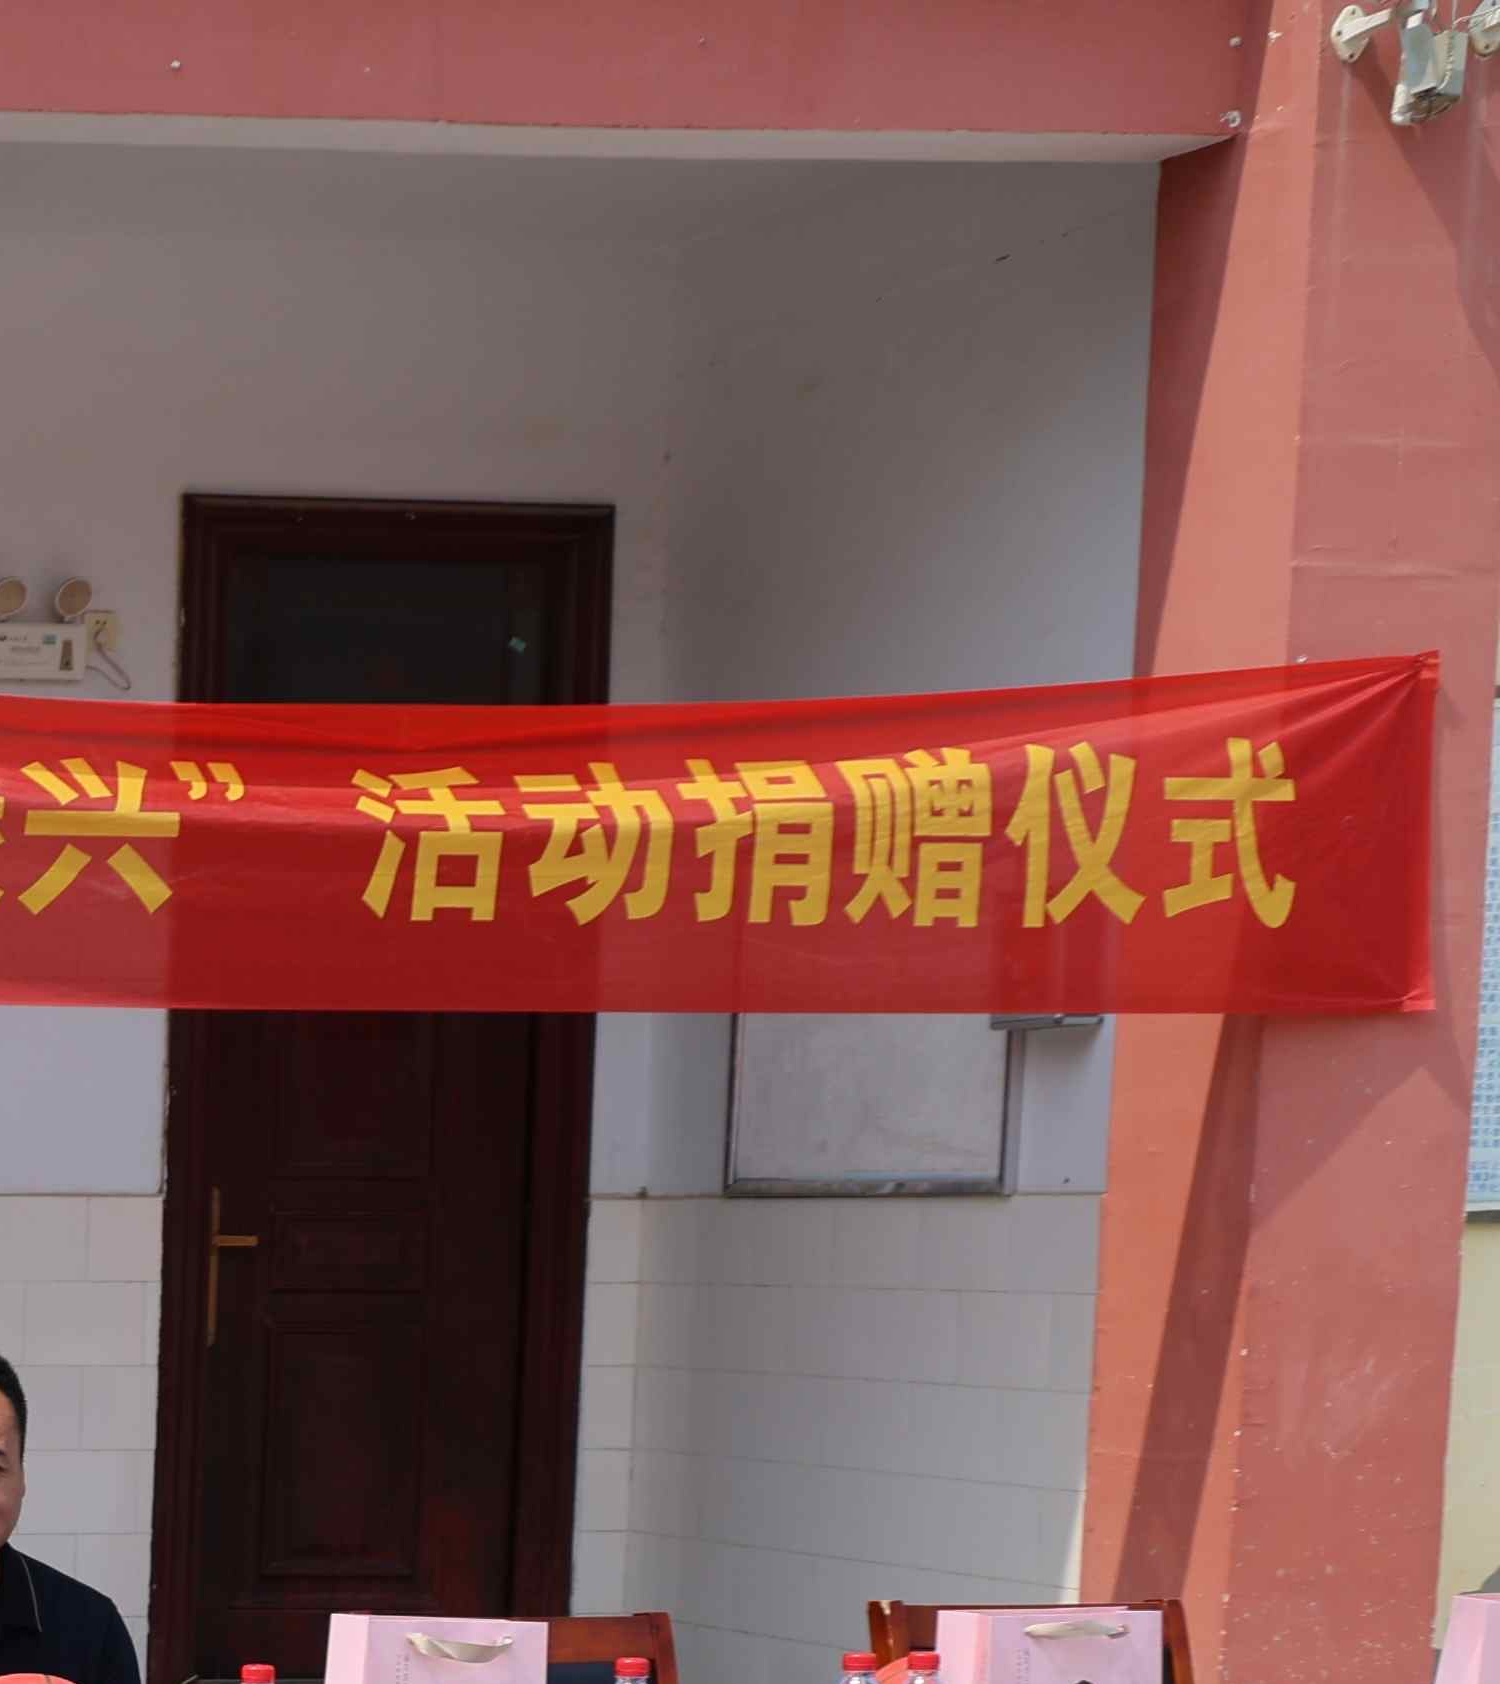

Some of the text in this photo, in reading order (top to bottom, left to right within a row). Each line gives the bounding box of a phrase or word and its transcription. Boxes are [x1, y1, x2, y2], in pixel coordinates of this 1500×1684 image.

[353, 736, 1296, 928] 活动捐赠仪式
